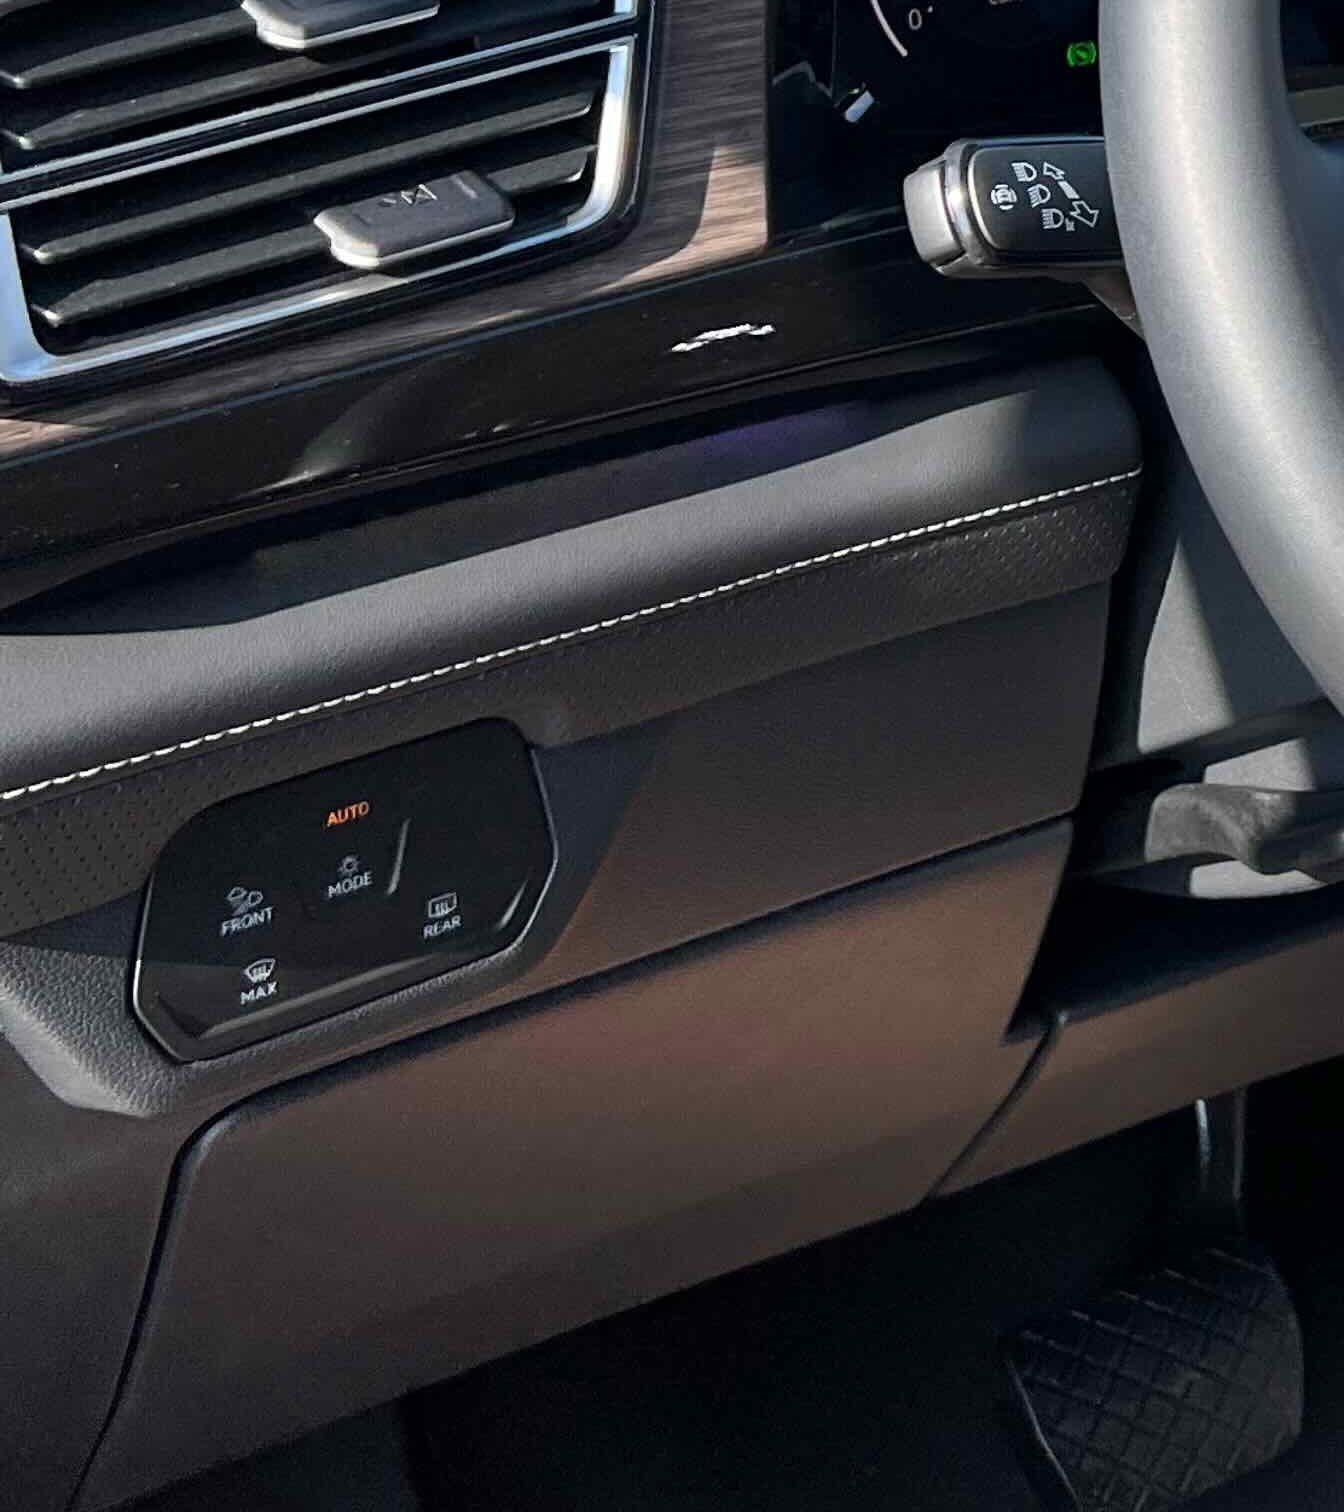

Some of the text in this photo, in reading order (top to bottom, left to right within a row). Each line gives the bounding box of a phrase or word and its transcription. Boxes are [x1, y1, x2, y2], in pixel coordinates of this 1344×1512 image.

[908, 10, 923, 30] 0
[326, 801, 369, 827] AUTO
[327, 871, 374, 899] MODE
[220, 906, 274, 936] FRONT
[423, 915, 462, 939] REAR
[239, 981, 278, 1005] MAX
